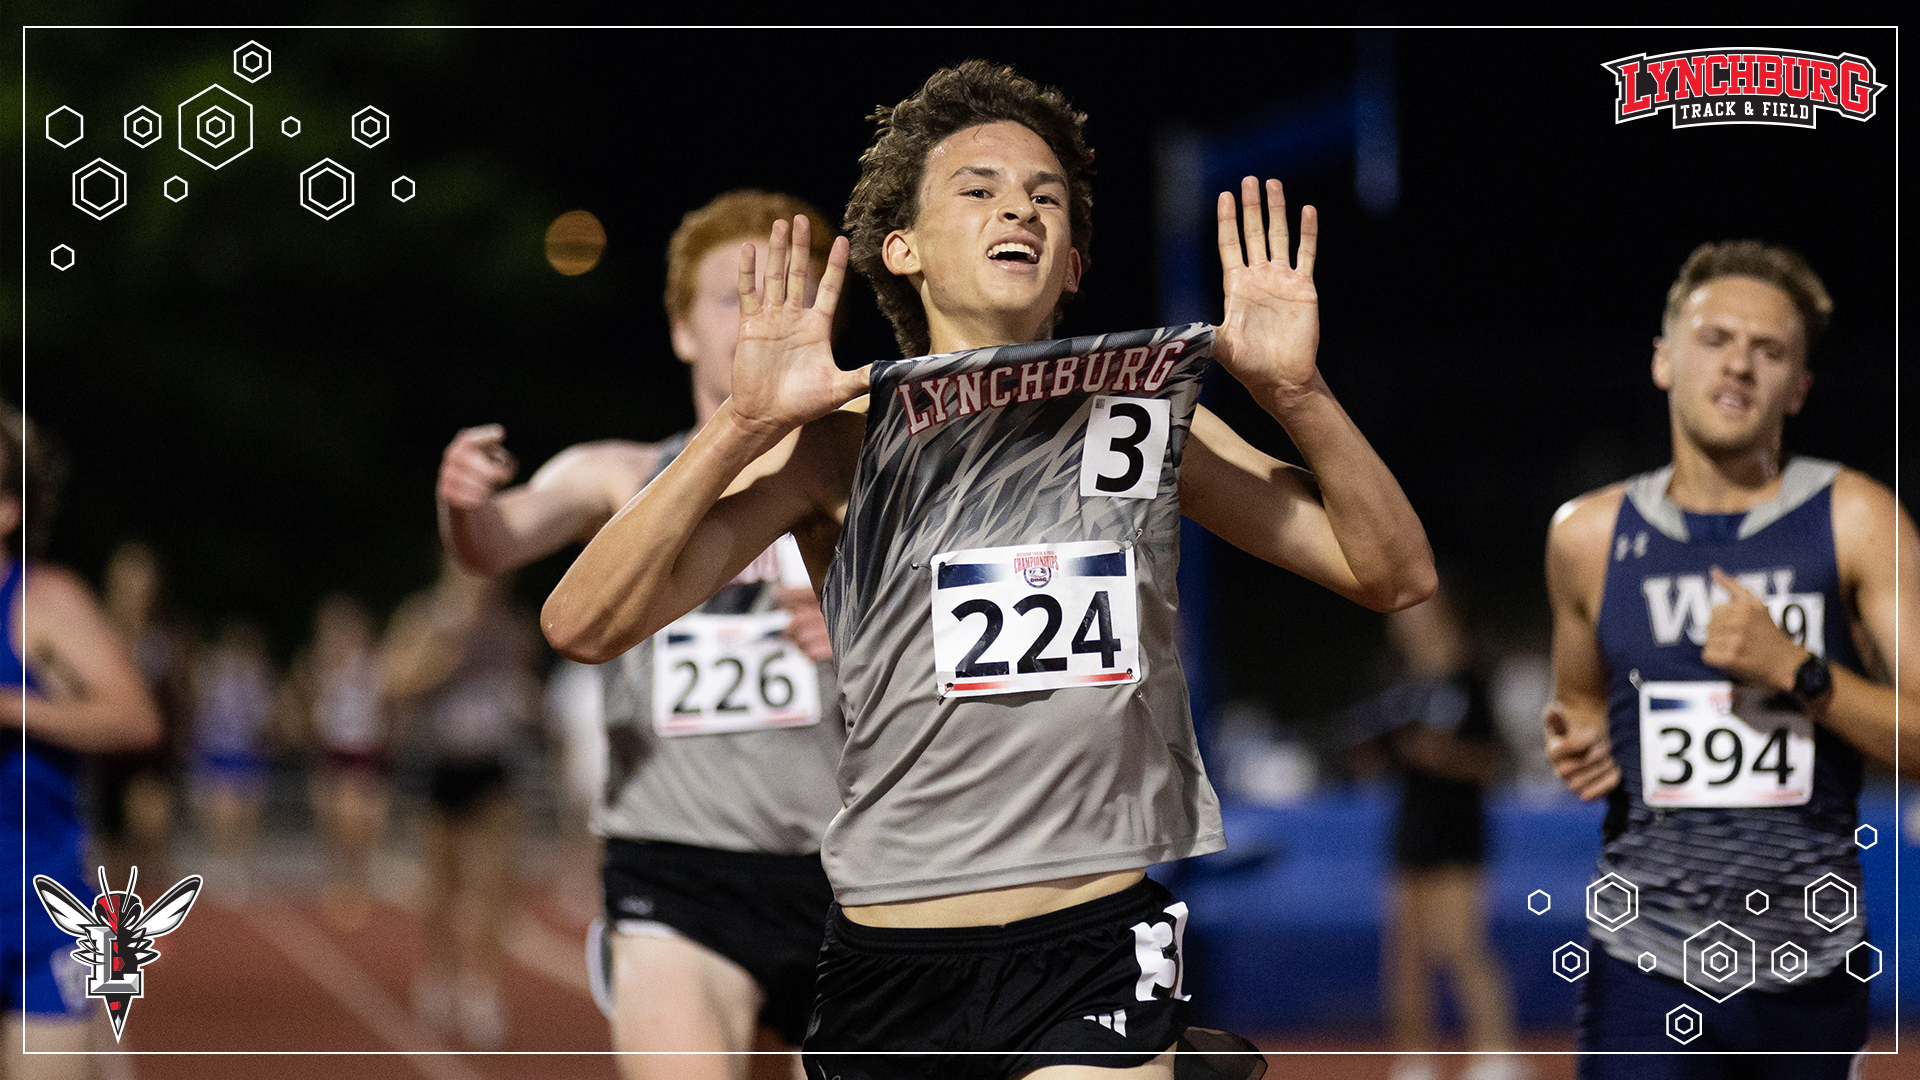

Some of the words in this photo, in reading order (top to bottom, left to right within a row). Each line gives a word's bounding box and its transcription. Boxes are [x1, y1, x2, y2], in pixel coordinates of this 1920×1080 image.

[898, 340, 1187, 435] LYNCHBURG
[1095, 402, 1152, 493] 3
[1013, 555, 1059, 573] CHAMPIONSHIPS
[950, 590, 1122, 678] 224
[670, 651, 794, 714] 226
[1657, 726, 1795, 787] 394
